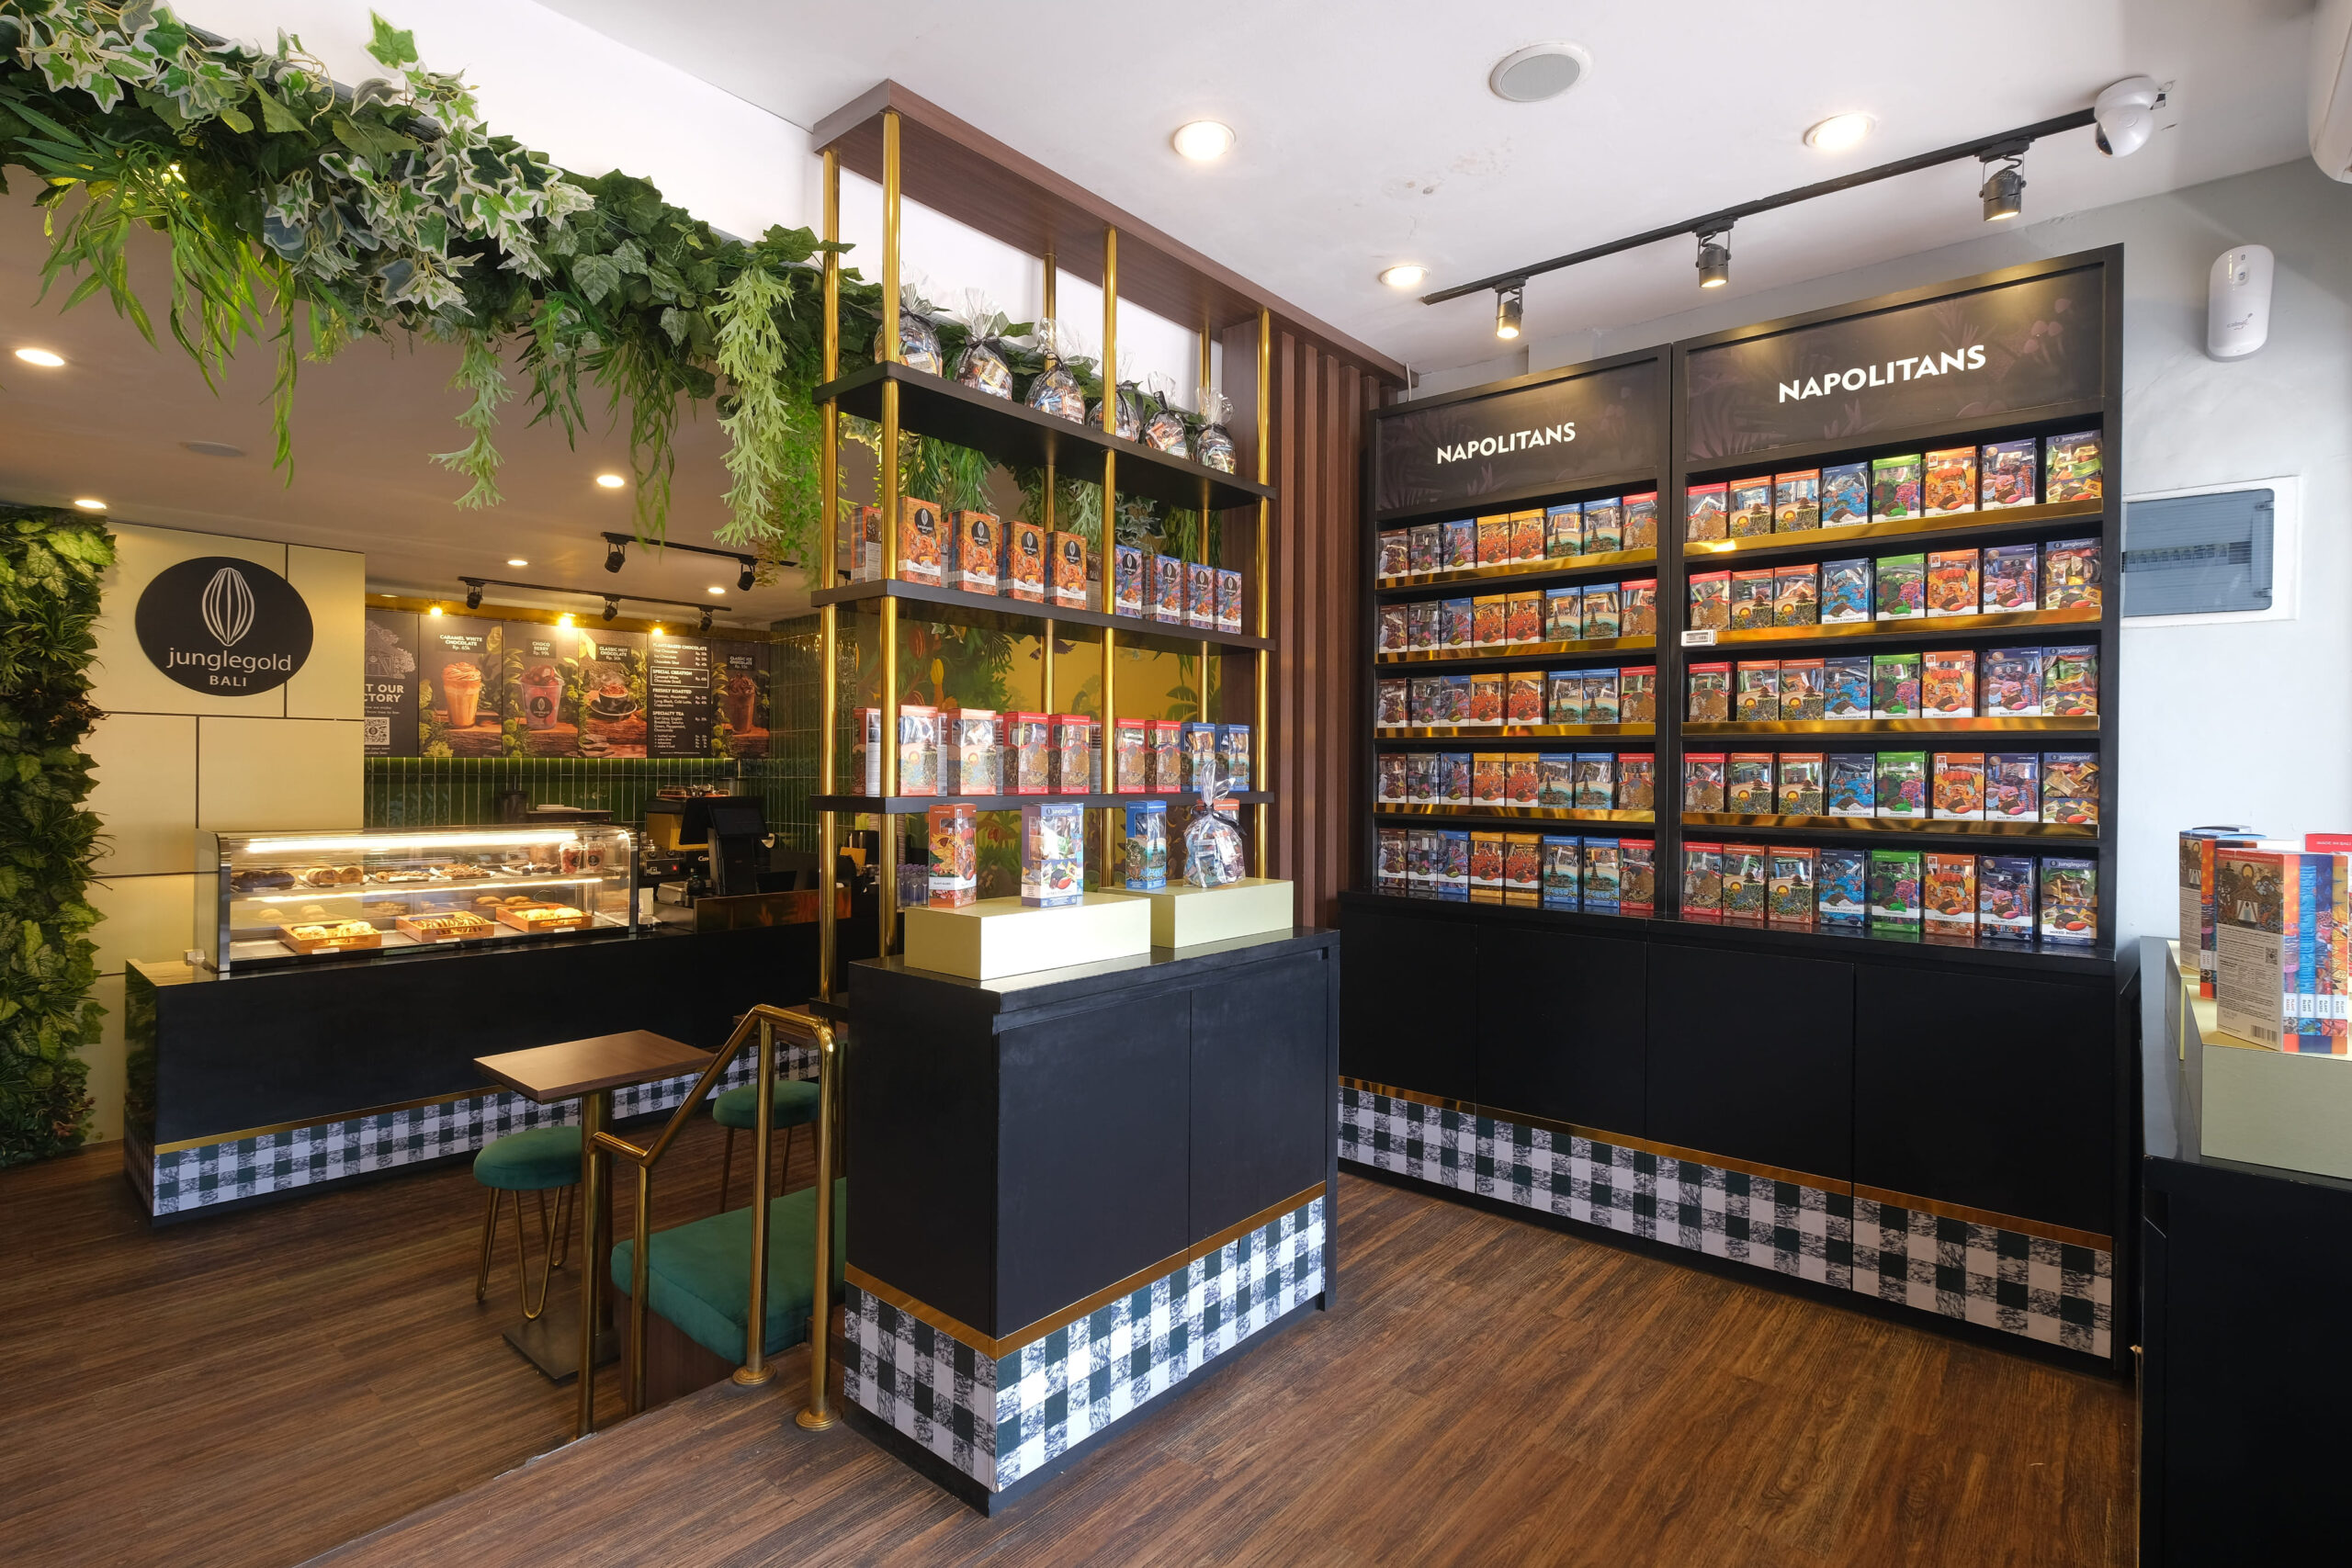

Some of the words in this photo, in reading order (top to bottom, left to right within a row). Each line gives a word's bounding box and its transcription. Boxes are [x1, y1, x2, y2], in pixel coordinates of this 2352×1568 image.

[1779, 344, 1986, 403] NAPOLITANS
[1436, 422, 1577, 465] NAPOLITANS
[166, 647, 291, 673] junglegold
[209, 675, 247, 687] BALI
[378, 684, 404, 694] OUR
